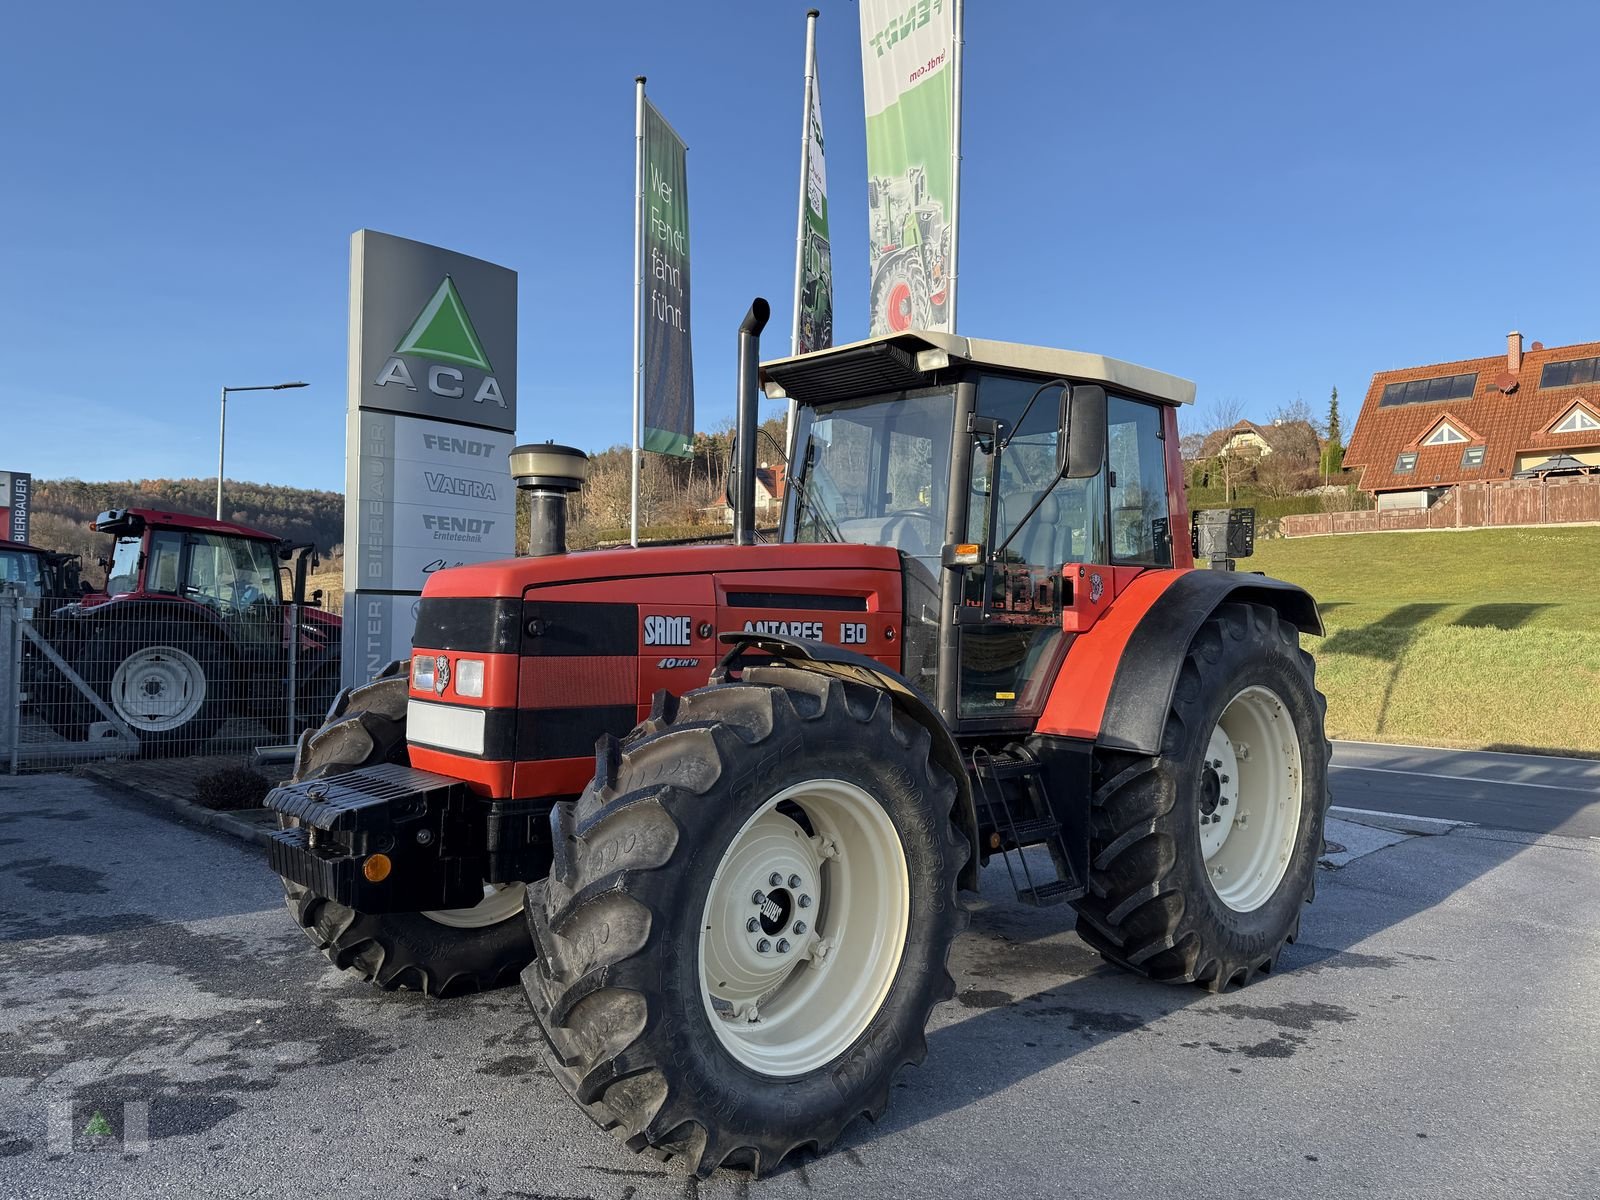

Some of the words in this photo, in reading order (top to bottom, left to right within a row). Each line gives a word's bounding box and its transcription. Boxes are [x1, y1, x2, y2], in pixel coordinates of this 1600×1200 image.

[650, 161, 672, 206] Wer
[651, 205, 686, 256] Fendt
[373, 356, 508, 409] ACA
[423, 433, 496, 458] FENDT
[368, 423, 386, 578] BIERBAUER
[424, 471, 497, 501] VALTRA
[14, 478, 27, 542] BIERBAUER
[422, 514, 496, 534] FENDT
[433, 530, 483, 543] Erntetechnik
[965, 599, 1005, 609] tuo
[644, 615, 692, 646] SAME
[743, 620, 824, 642] ANTARES
[839, 622, 868, 644] 130
